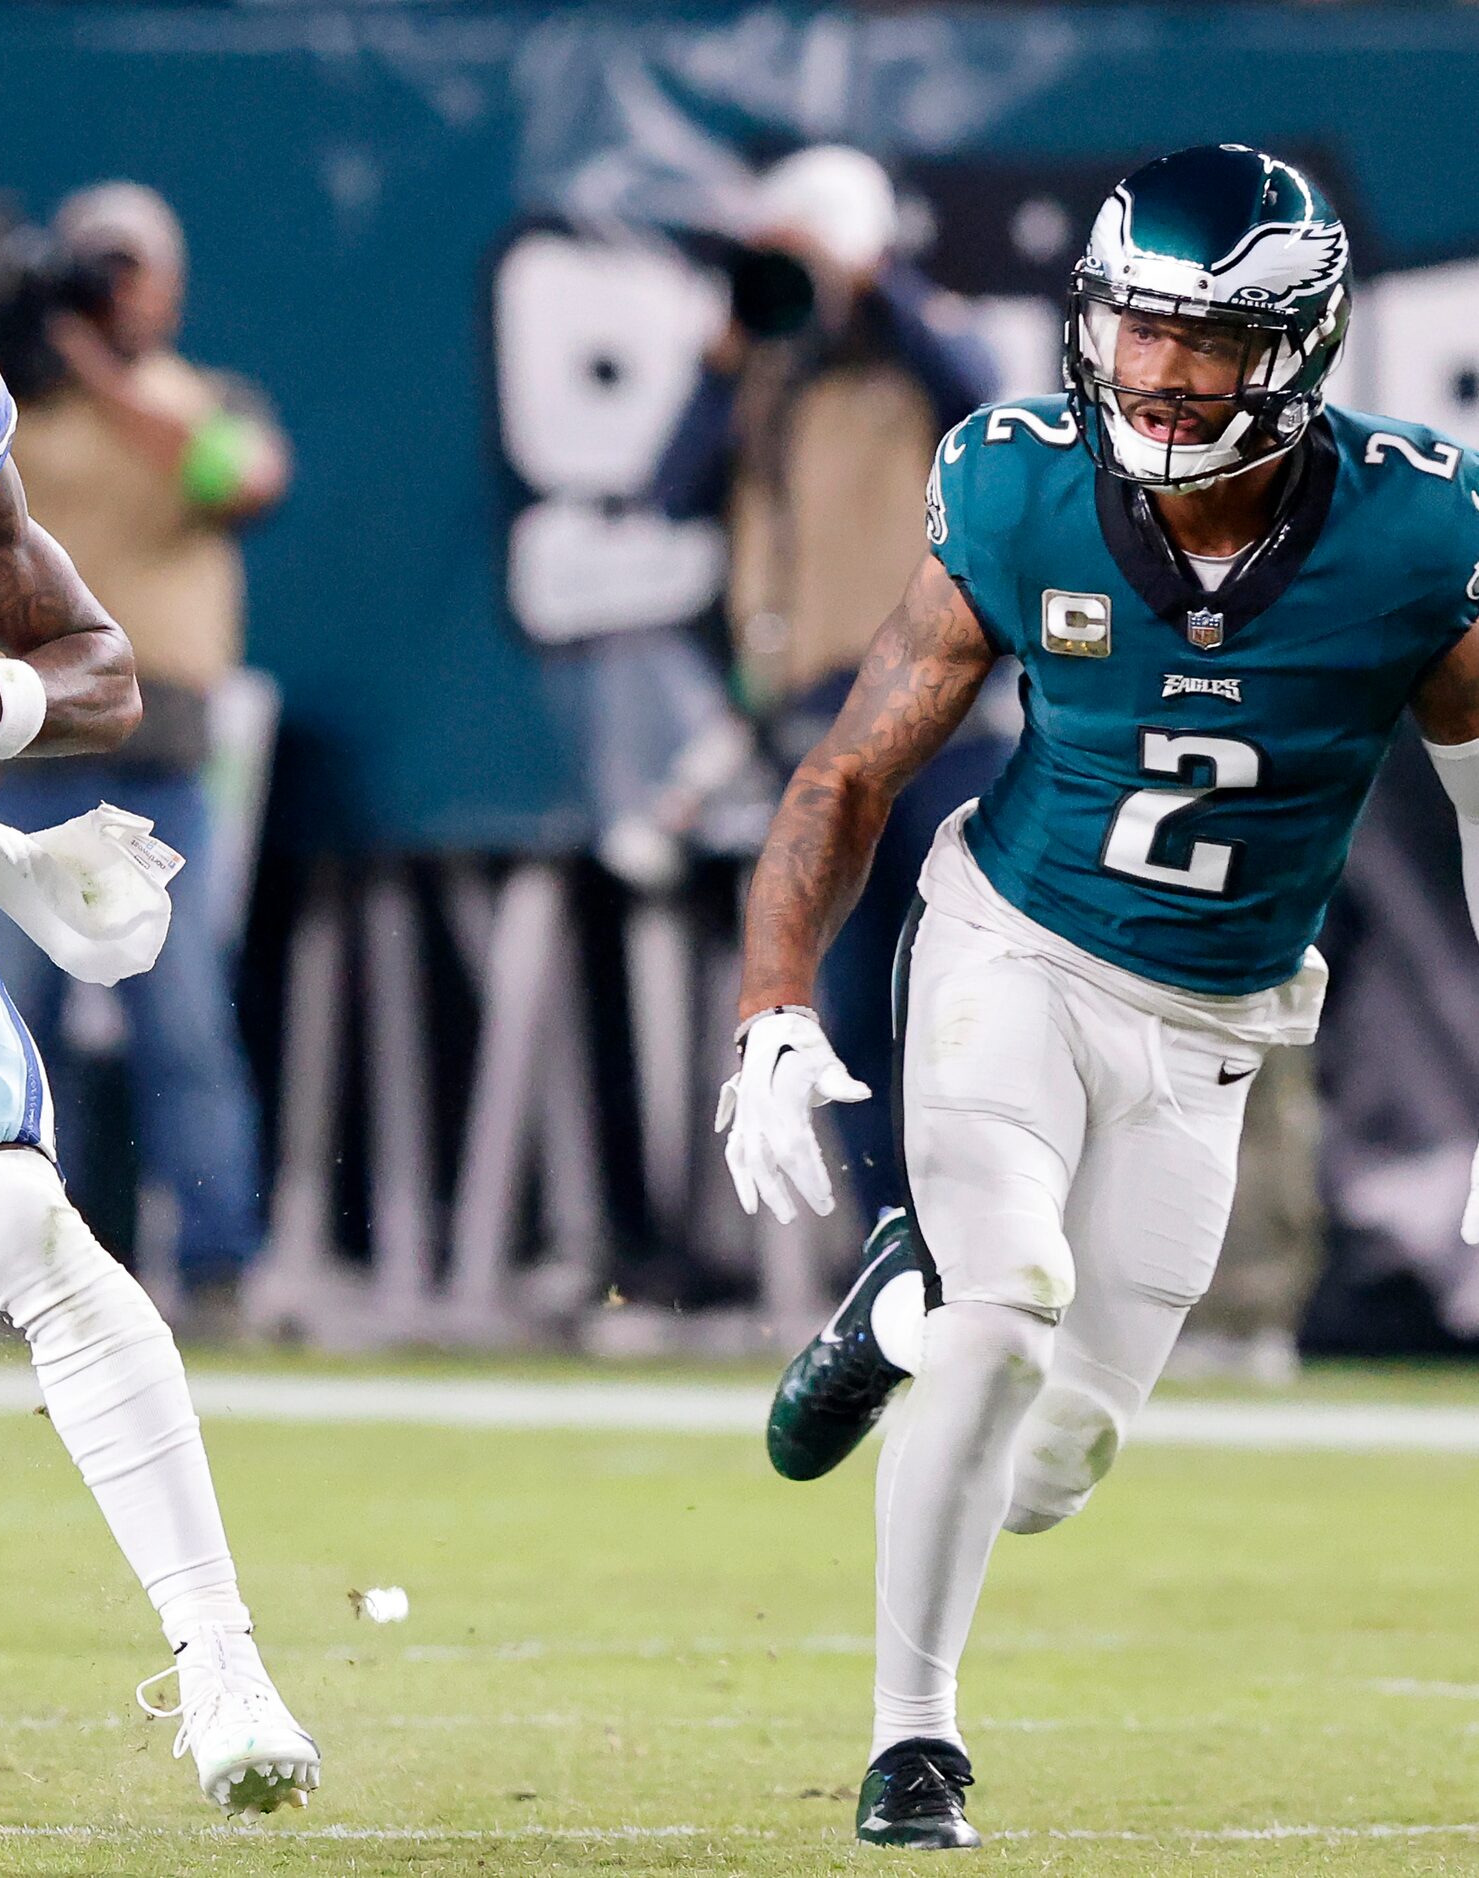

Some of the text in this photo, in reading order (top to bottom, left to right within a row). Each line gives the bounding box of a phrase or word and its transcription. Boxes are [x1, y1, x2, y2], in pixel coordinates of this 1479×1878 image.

[984, 407, 1078, 447] 2
[1363, 431, 1461, 480] 2
[1047, 596, 1106, 641] C
[1161, 673, 1242, 704] EAGLES
[1100, 727, 1261, 894] 2
